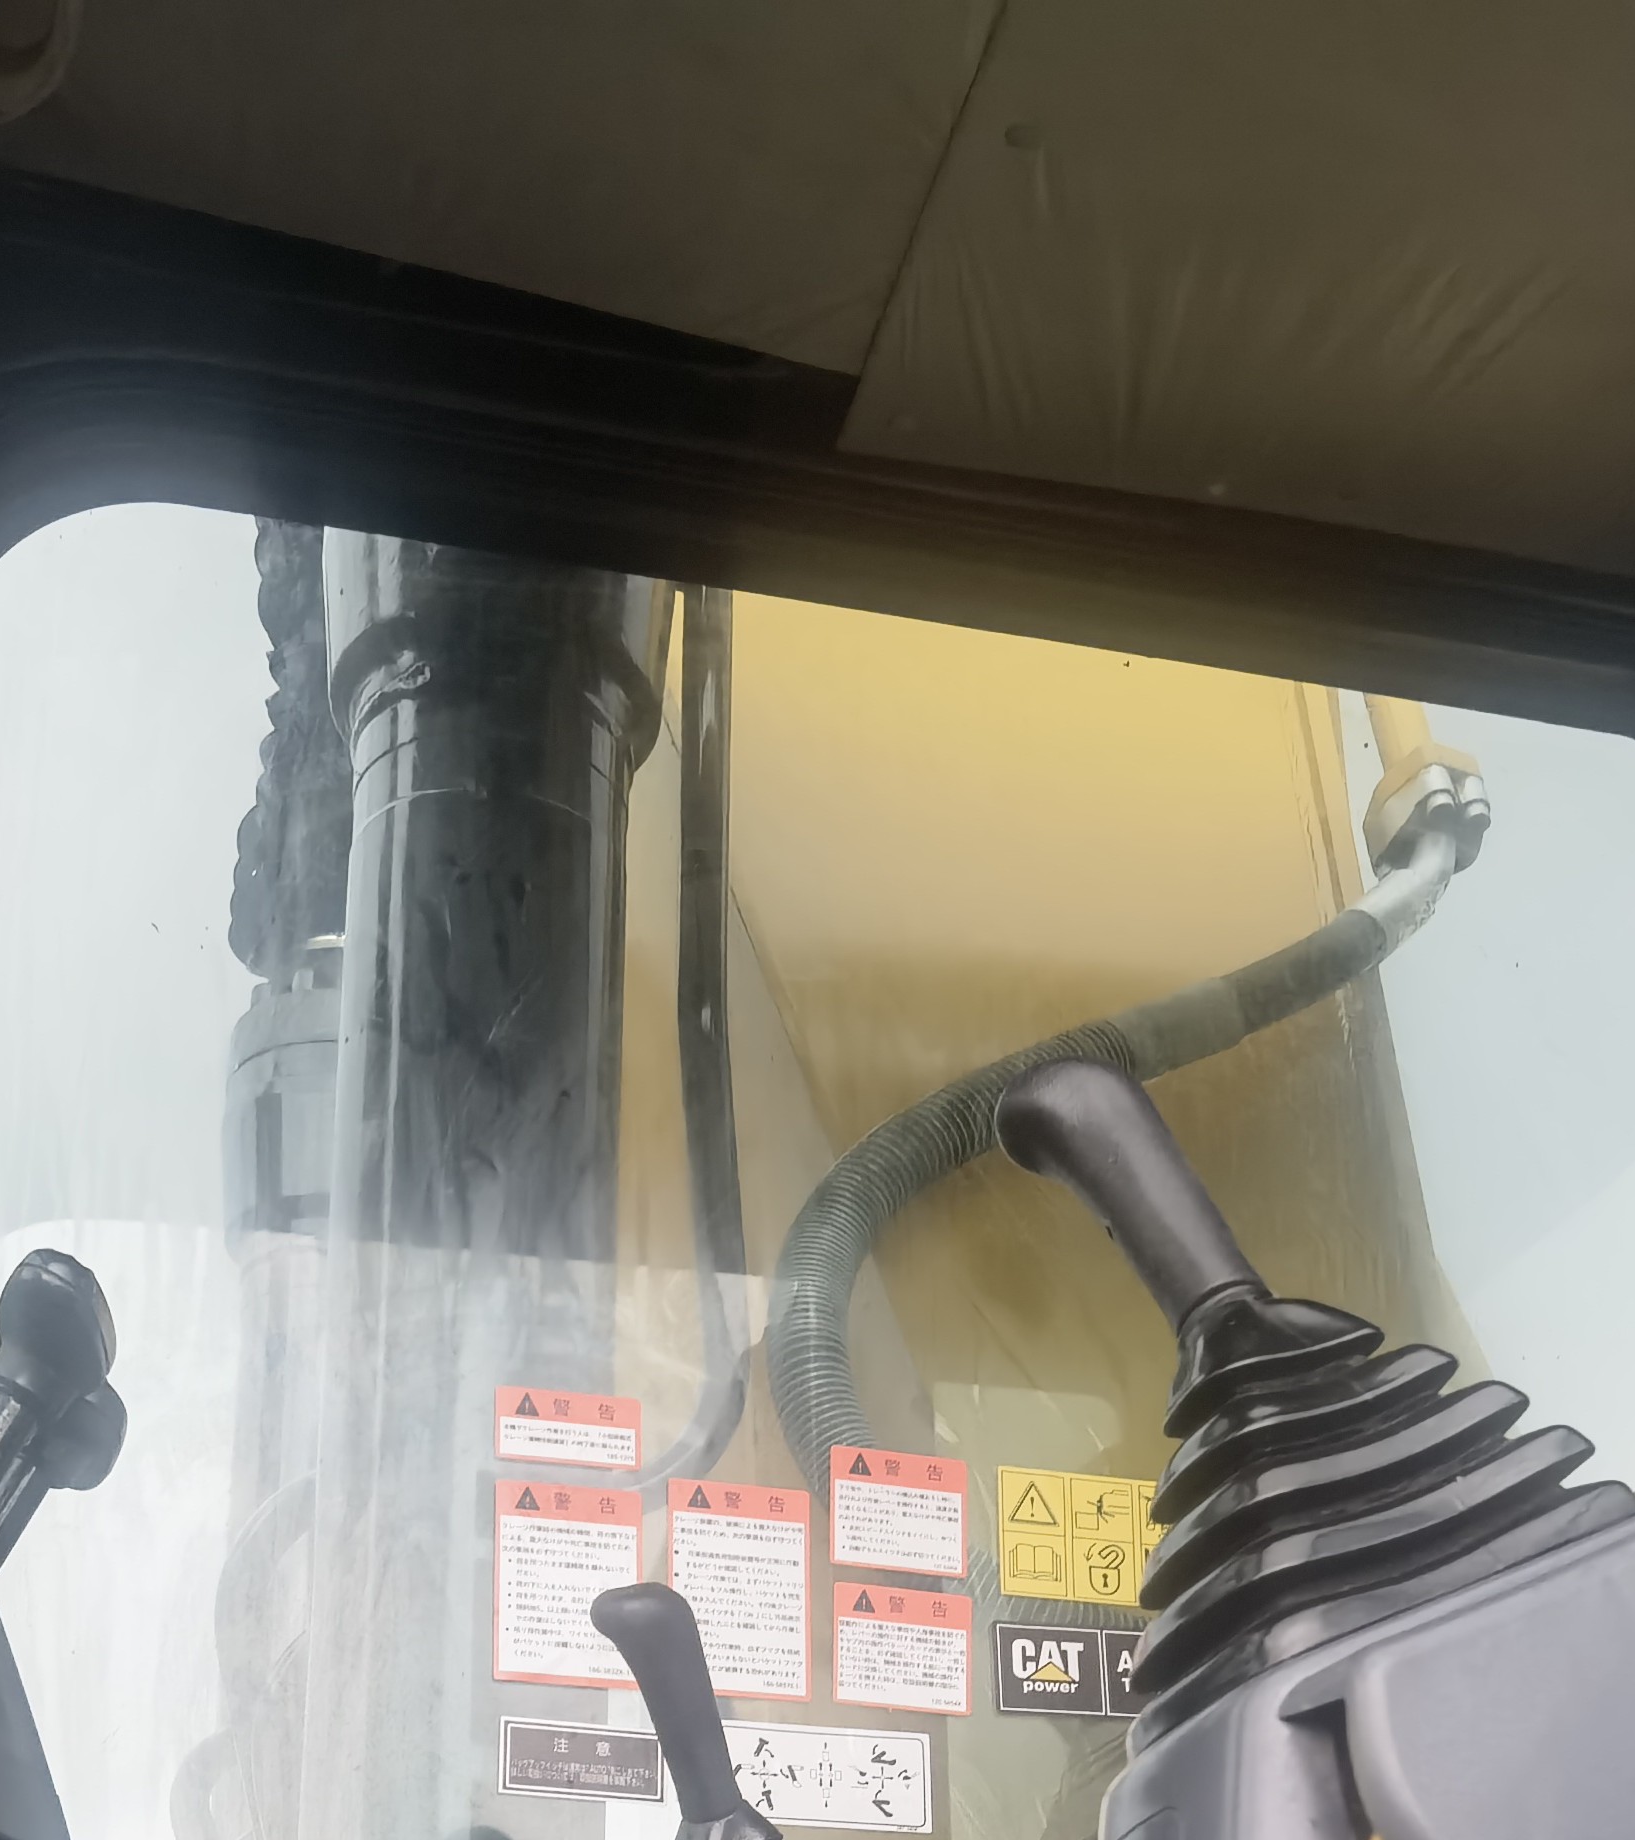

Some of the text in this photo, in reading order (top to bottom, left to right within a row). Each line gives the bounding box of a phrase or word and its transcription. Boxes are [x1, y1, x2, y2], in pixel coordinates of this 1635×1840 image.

[724, 1491, 785, 1513] 警告
[1011, 1638, 1084, 1682] CAT
[1023, 1680, 1079, 1694] power
[553, 1737, 611, 1757] 注意
